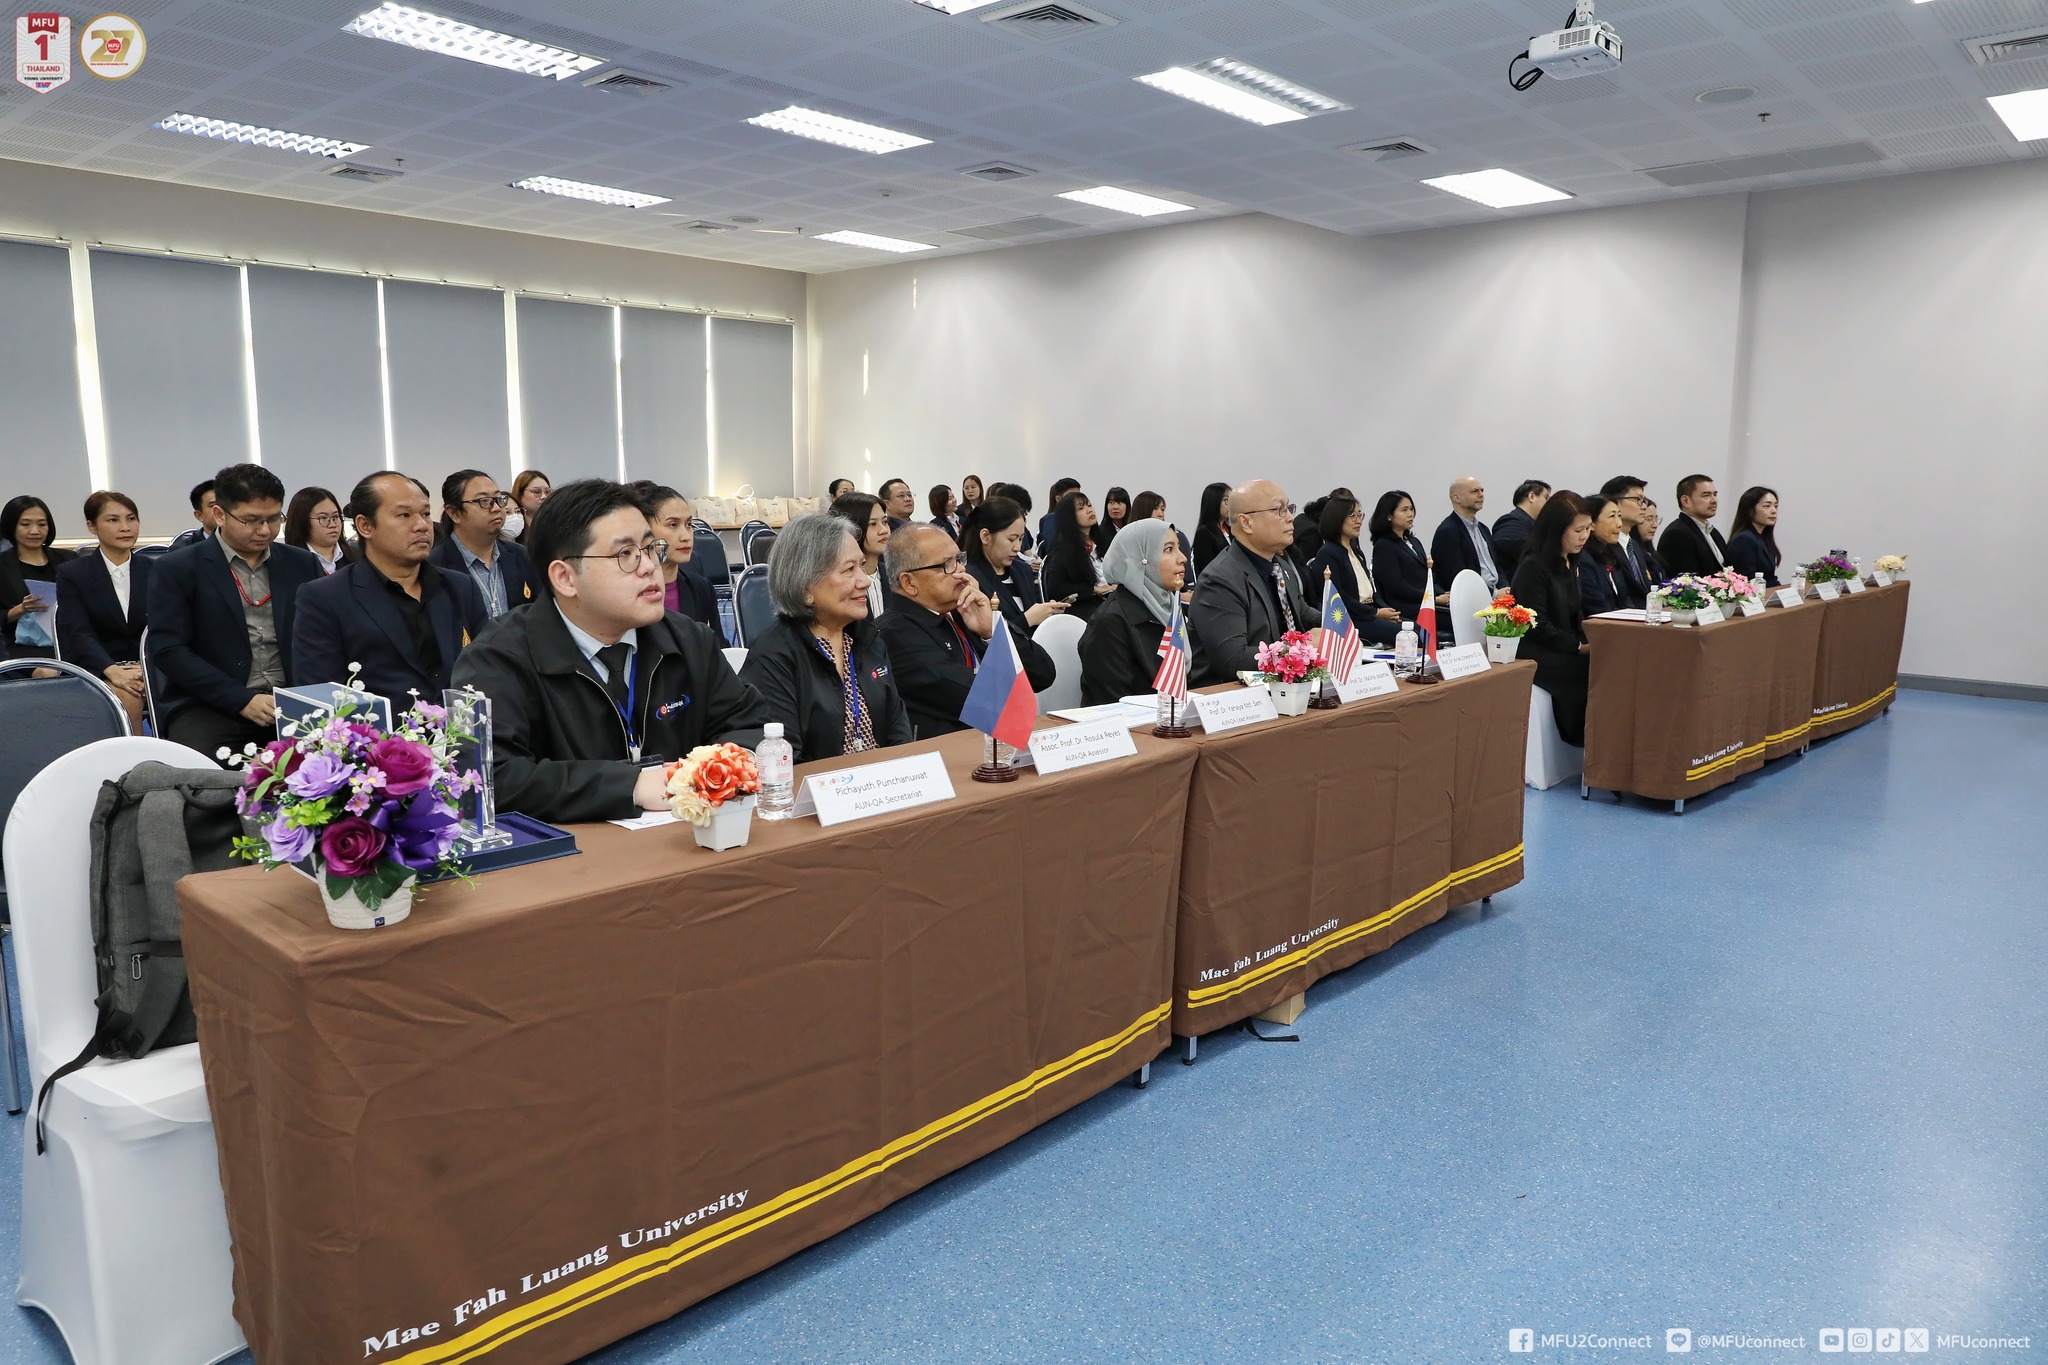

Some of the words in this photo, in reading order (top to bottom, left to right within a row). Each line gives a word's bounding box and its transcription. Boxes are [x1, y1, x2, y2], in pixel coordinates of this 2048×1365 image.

[1227, 703, 1244, 712] Yahaya
[1246, 713, 1261, 721] Assessor
[1041, 742, 1060, 752] Assoc.
[1060, 739, 1074, 749] Prof.
[1084, 732, 1105, 743] Rosula
[1104, 730, 1121, 739] Reyes
[1065, 752, 1087, 762] AUN-QA
[1088, 748, 1110, 757] Assessor
[835, 781, 876, 796] Pichayuth
[876, 771, 928, 788] Punchanuwat
[854, 797, 884, 811] AUN-QA
[885, 790, 923, 804] Secretariat
[1200, 968, 1230, 983] Mae
[1233, 956, 1251, 973] Fah
[1255, 942, 1288, 962] Luang
[1290, 917, 1340, 945] University
[363, 1320, 440, 1358] Mae
[453, 1287, 507, 1326] Fah
[520, 1244, 609, 1294] Luang
[619, 1189, 749, 1248] University
